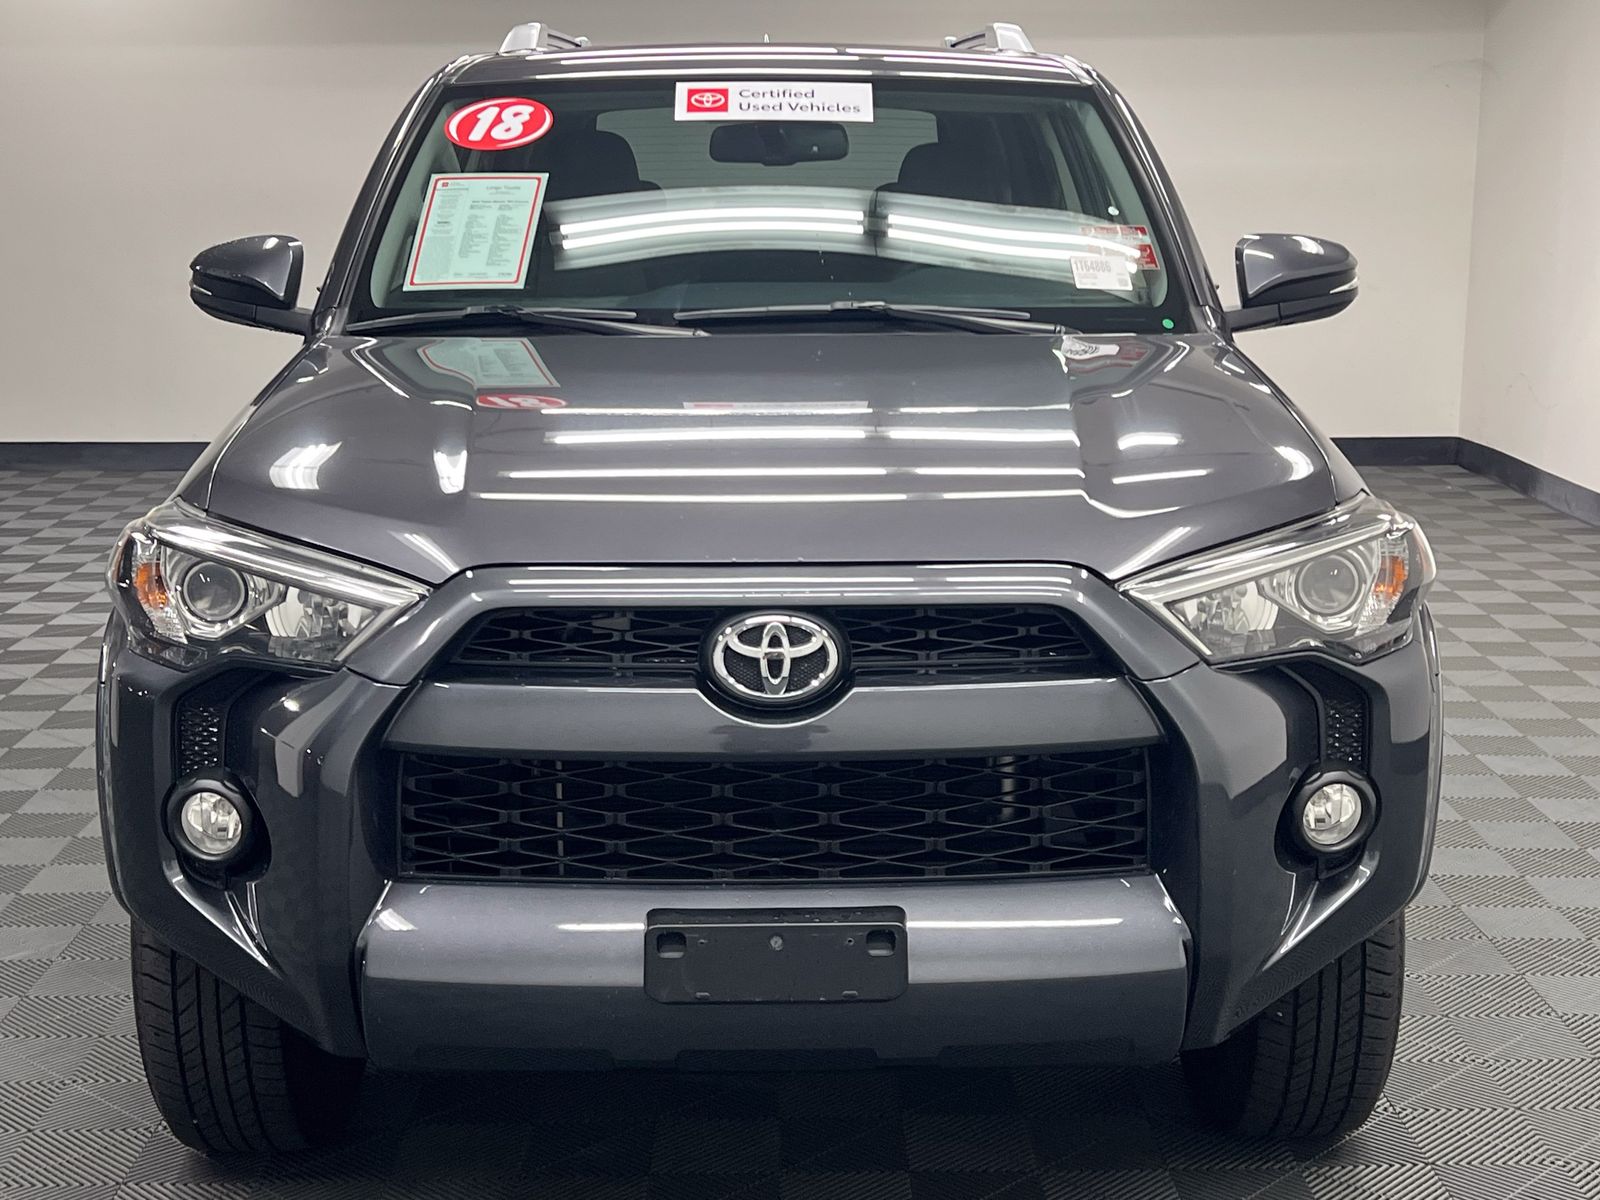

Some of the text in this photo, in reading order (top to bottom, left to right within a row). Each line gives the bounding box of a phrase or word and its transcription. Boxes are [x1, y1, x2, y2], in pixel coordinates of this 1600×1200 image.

[738, 89, 815, 98] Certified
[738, 102, 861, 113] Used Vehicles
[468, 104, 535, 142] 18
